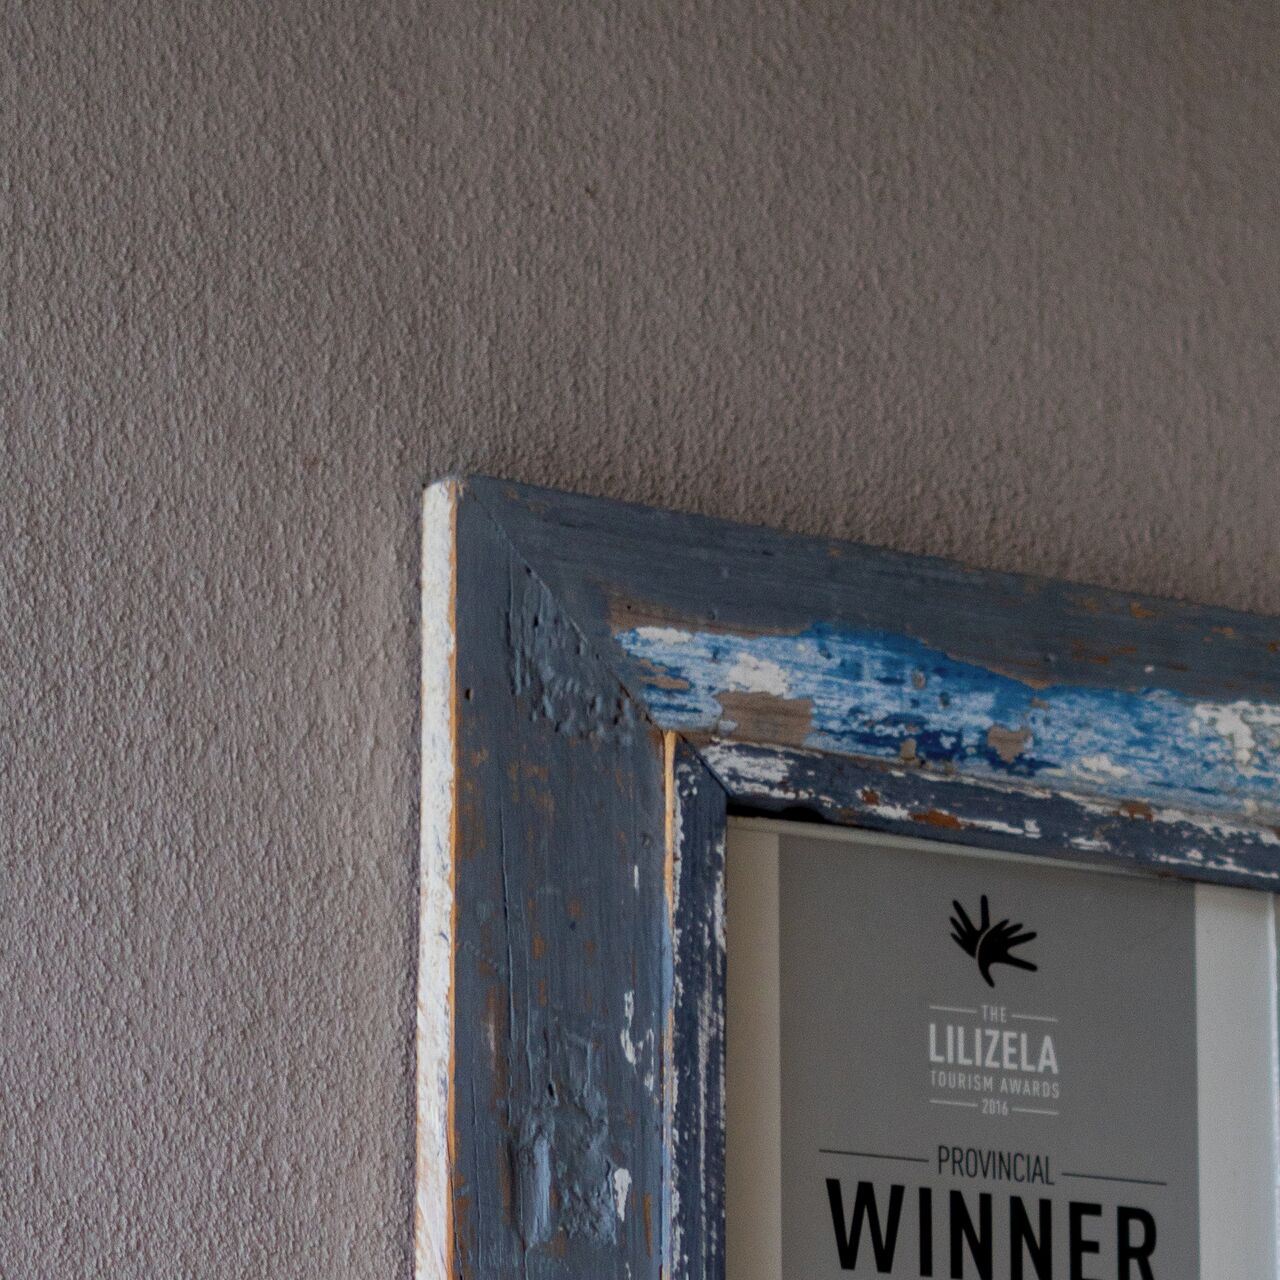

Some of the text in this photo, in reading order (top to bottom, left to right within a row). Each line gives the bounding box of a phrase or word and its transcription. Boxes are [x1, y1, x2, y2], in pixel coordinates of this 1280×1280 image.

[982, 1005, 1007, 1023] THE
[929, 1024, 1059, 1074] LILIZELA
[931, 1070, 1060, 1099] TOURISM AWARDS
[982, 1099, 1009, 1116] 2016
[937, 1145, 1055, 1186] PROVINCIAL
